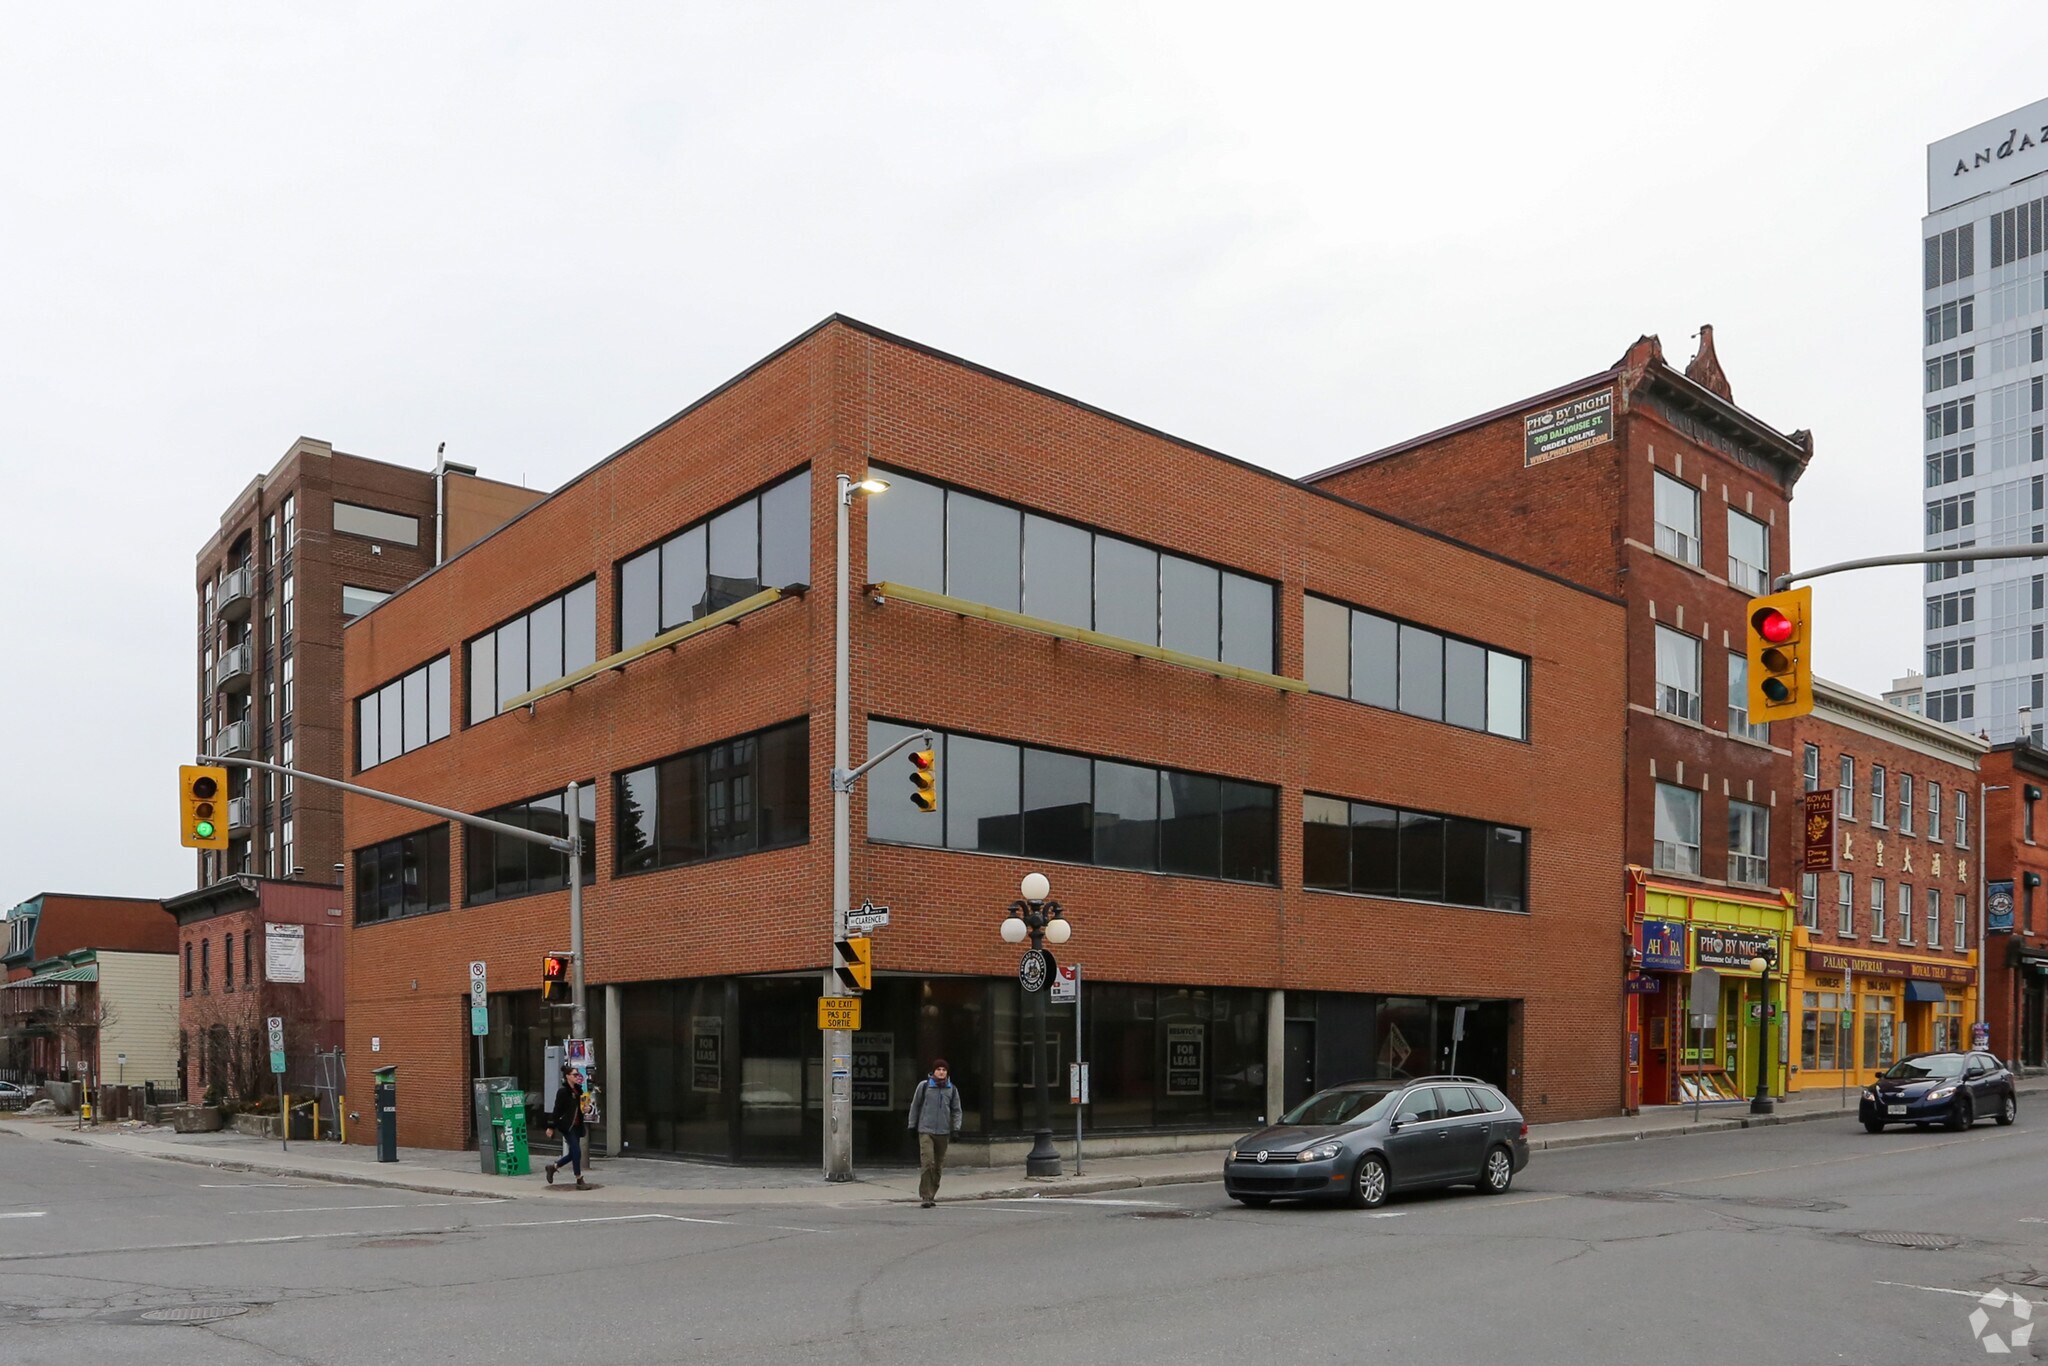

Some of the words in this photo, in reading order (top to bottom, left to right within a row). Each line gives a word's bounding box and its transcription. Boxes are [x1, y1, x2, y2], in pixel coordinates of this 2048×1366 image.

[1556, 406, 1571, 420] BY
[1574, 393, 1611, 414] NIGHT
[1534, 433, 1548, 445] 309
[1549, 420, 1591, 440] DALHOUSIE
[1592, 415, 1603, 426] ST.
[1541, 438, 1567, 452] ORDER
[1567, 429, 1596, 443] ONLINE
[1807, 793, 1832, 803] ROYAL
[1807, 801, 1830, 810] THAI
[855, 915, 881, 925] CLARENCE
[1725, 939, 1738, 954] BY
[1823, 955, 1848, 969] PALAIS
[1932, 966, 1947, 978] THAI
[826, 1000, 836, 1008] NO
[838, 1000, 853, 1008] EXIT
[700, 1038, 713, 1049] FOR
[1177, 1044, 1195, 1055] FOR
[696, 1050, 716, 1061] LEASE
[852, 1055, 878, 1066] FOR
[1173, 1056, 1197, 1066] LEASE
[852, 1067, 884, 1079] EASE
[505, 1119, 515, 1153] metro
